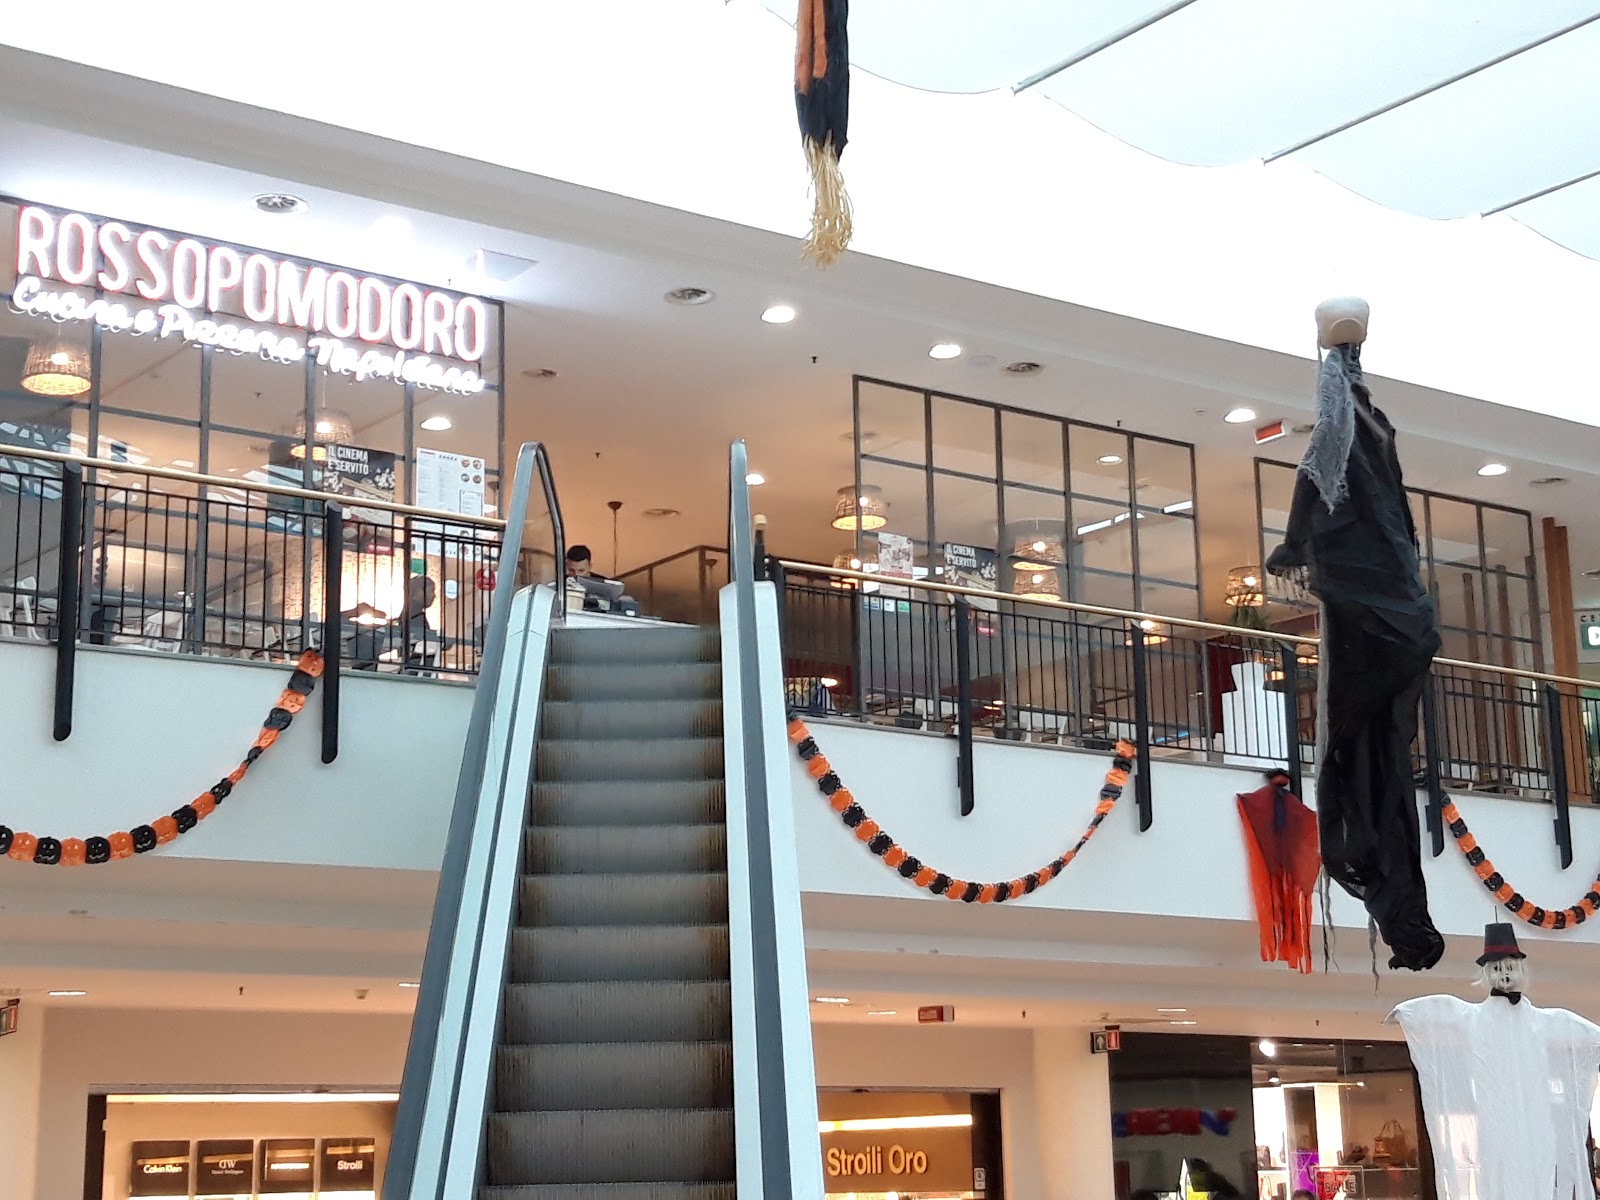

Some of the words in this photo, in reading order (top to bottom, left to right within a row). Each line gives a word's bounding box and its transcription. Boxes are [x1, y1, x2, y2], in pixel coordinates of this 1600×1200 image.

[17, 205, 487, 362] ROSSOPOMODORO
[328, 445, 337, 457] IL
[337, 447, 369, 464] CINEMA
[336, 460, 369, 475] SERVITO
[827, 1145, 883, 1177] Stroili
[888, 1144, 928, 1175] Oro
[1325, 1181, 1357, 1194] SALE
